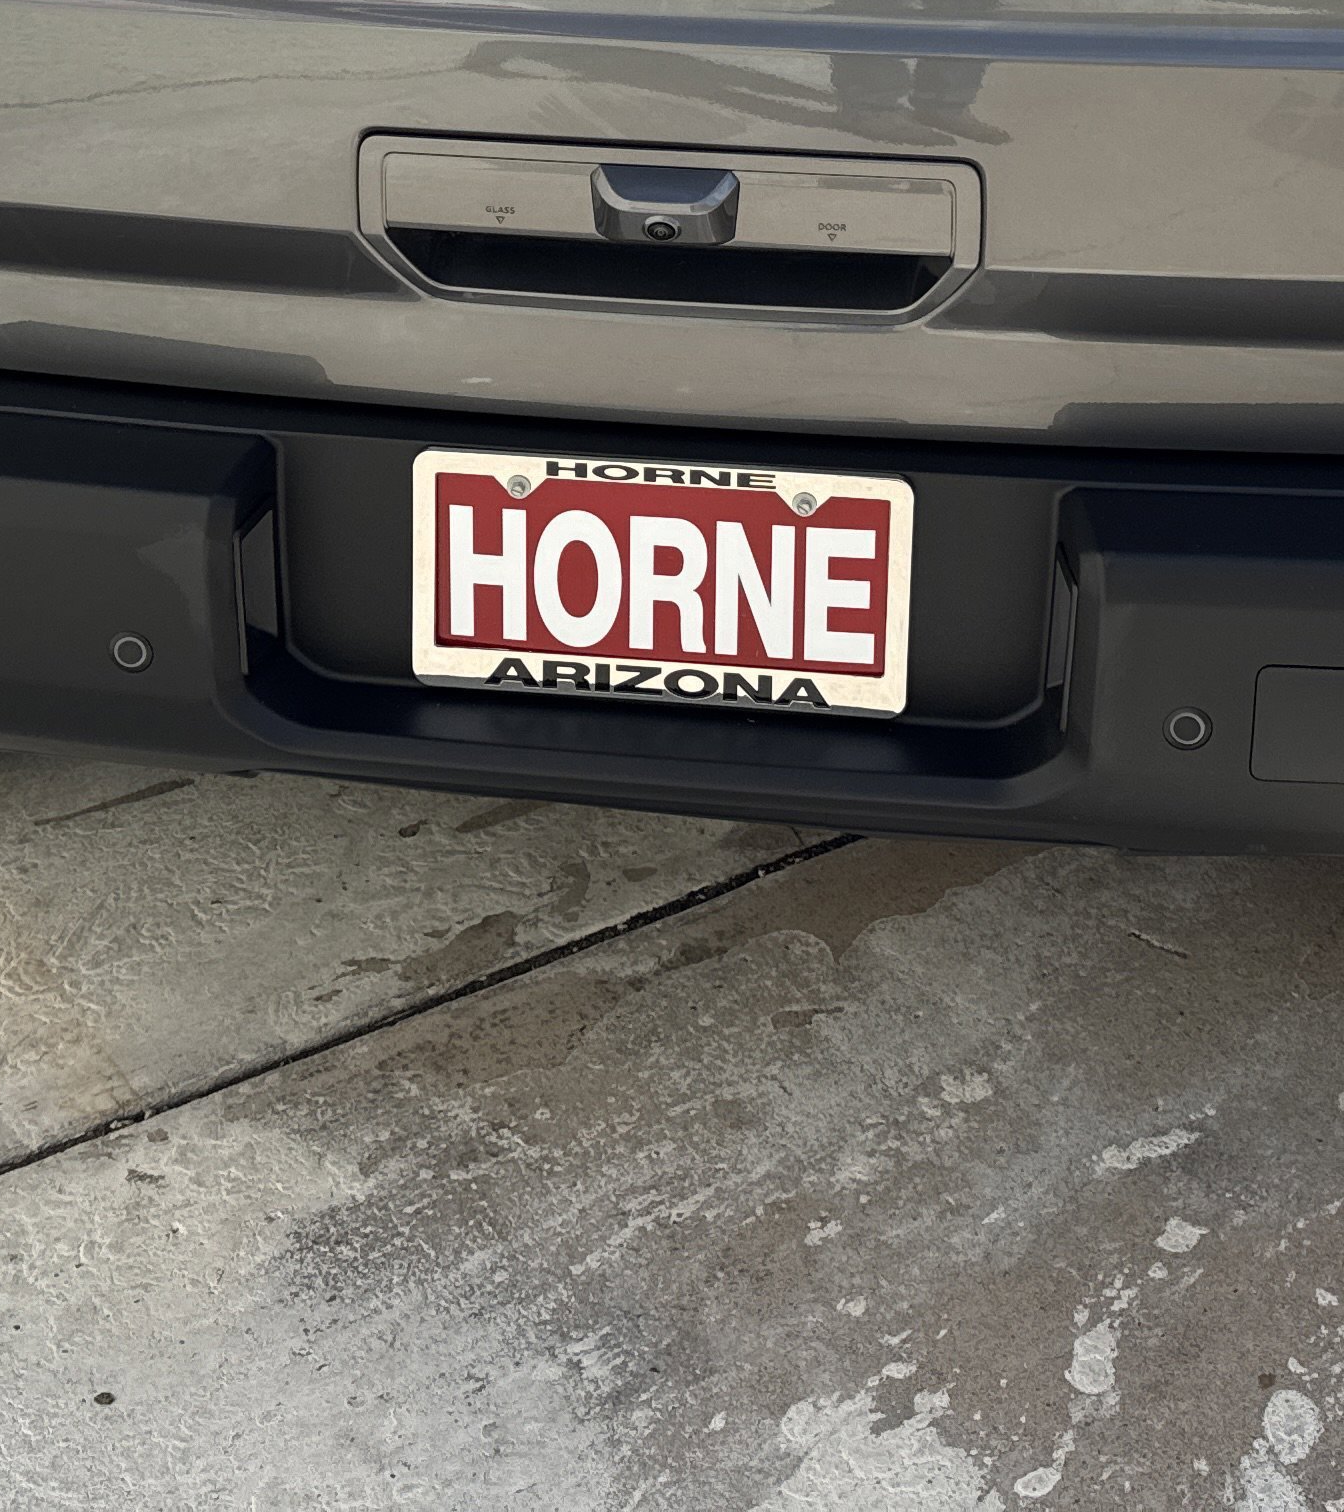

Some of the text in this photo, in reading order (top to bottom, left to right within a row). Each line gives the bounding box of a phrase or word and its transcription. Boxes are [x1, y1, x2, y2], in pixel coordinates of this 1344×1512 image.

[485, 204, 517, 215] GLASS
[817, 222, 848, 233] DOOR
[545, 460, 777, 490] HORNE
[448, 503, 878, 666] HORNE
[483, 656, 832, 709] ARIZONA
